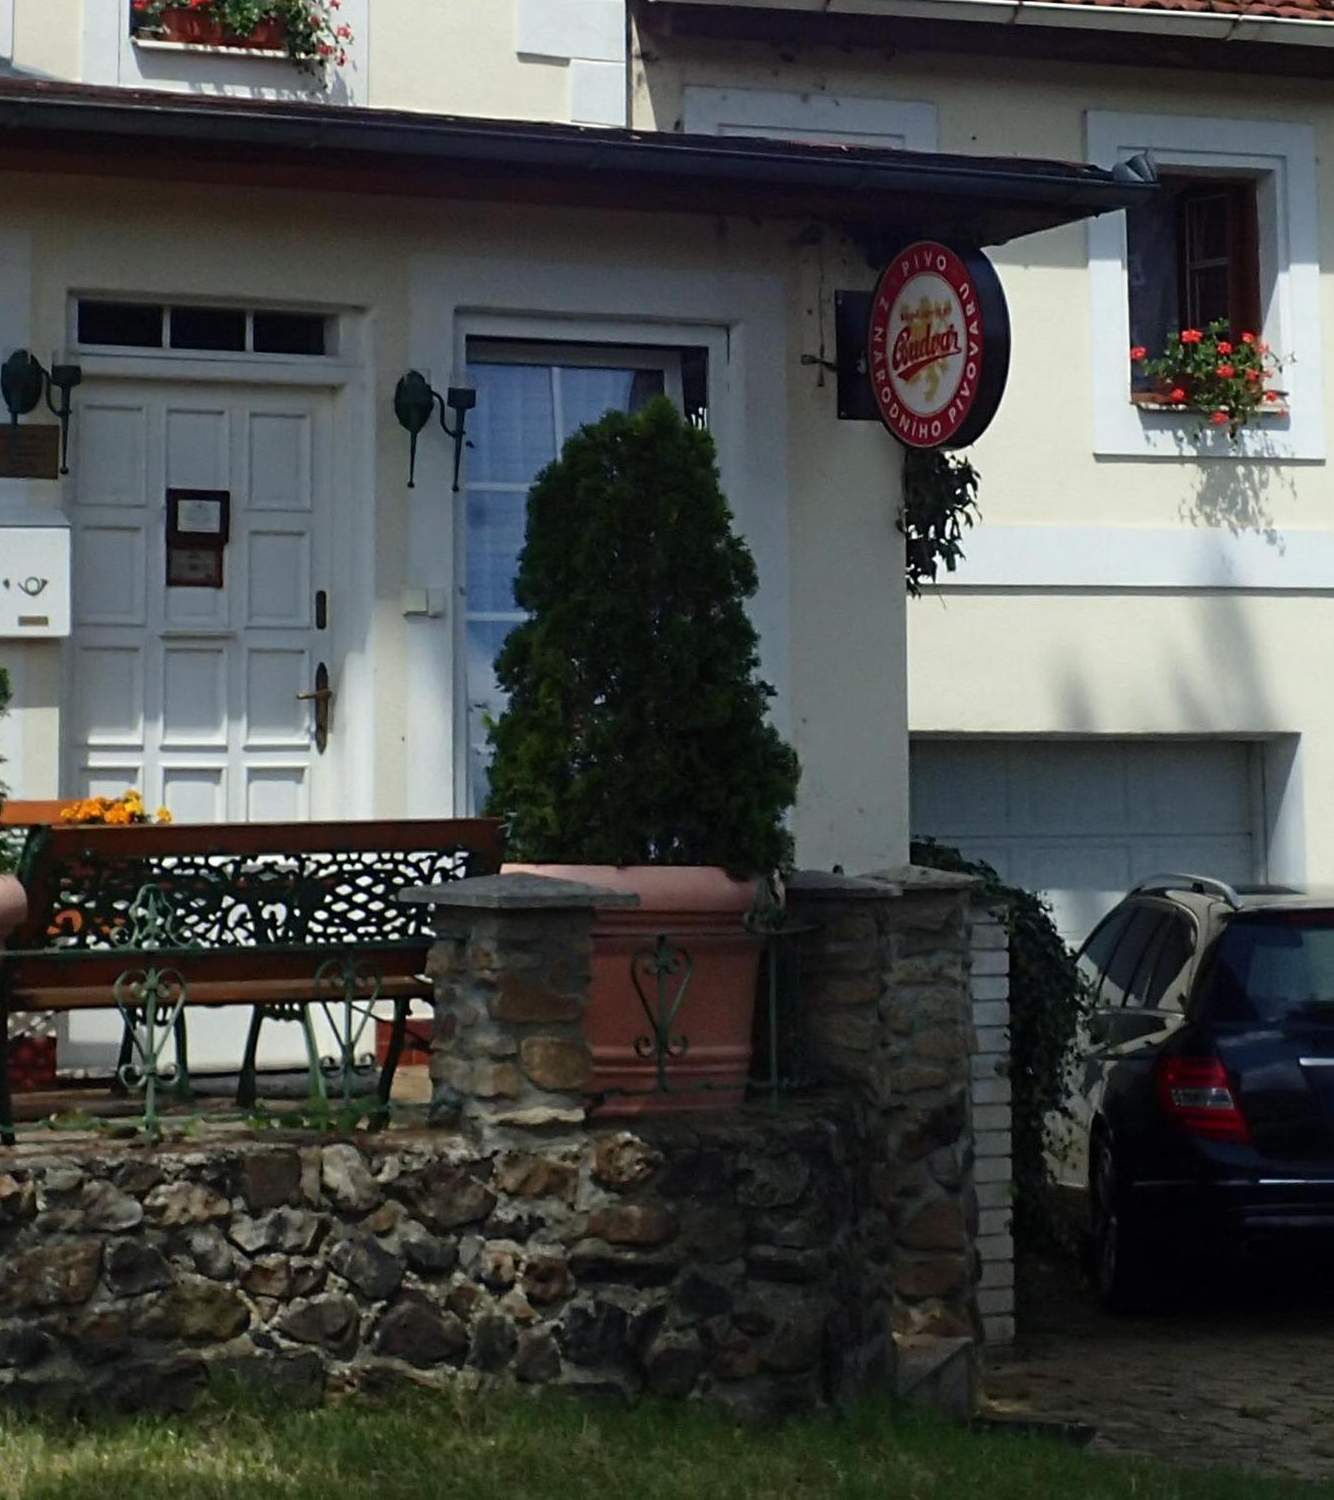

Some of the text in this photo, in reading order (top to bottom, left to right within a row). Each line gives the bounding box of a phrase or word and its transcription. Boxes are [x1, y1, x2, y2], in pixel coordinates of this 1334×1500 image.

[901, 251, 947, 276] PIVO
[878, 296, 890, 311] Z
[948, 282, 979, 424] PIVOVARU
